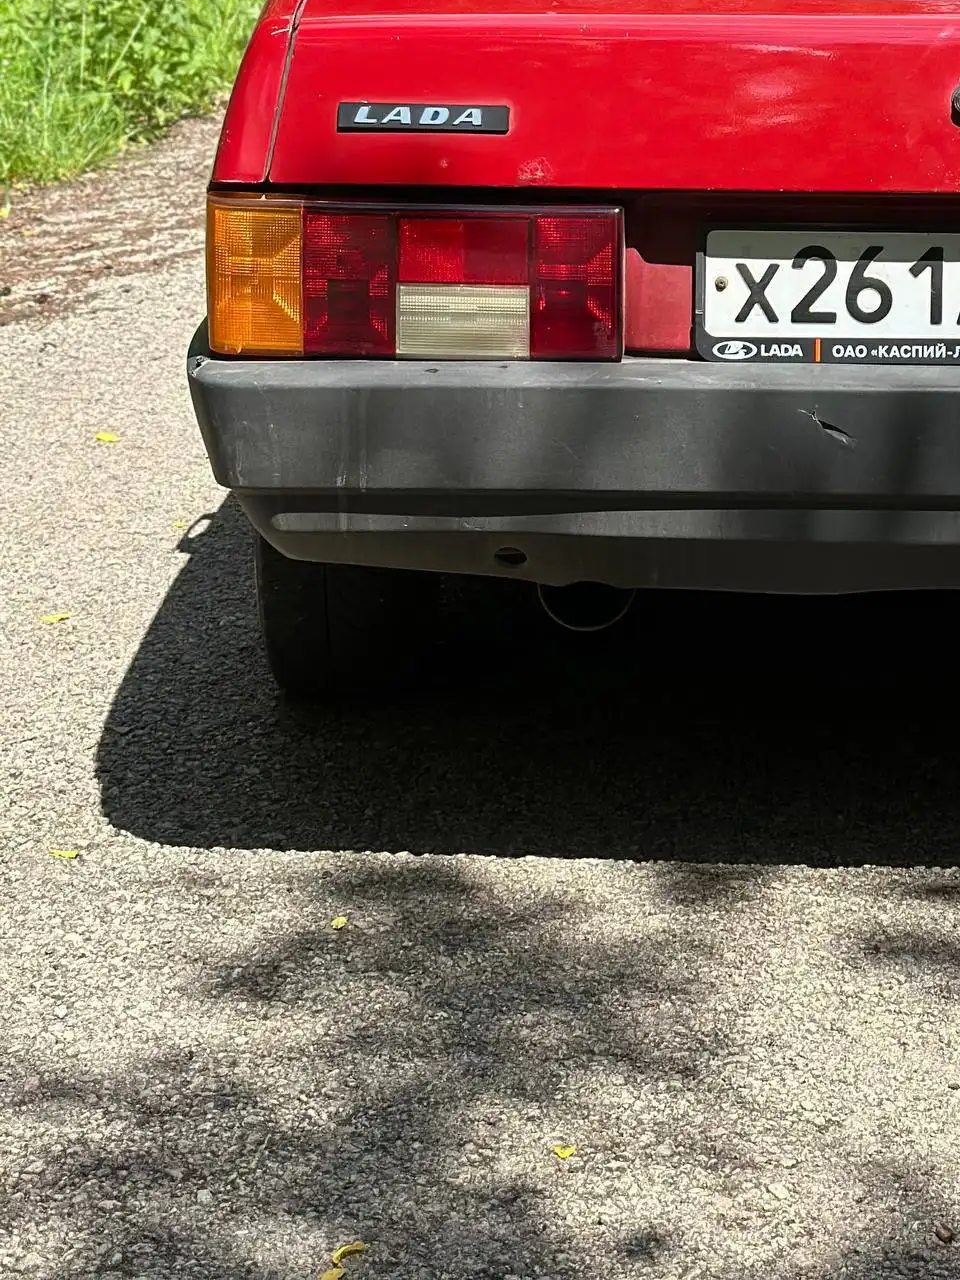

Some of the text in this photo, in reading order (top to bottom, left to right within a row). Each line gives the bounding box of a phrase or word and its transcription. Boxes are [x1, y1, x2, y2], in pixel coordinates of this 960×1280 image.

[353, 105, 483, 127] LADA
[760, 343, 803, 358] LADA
[831, 344, 868, 359] ОАО
